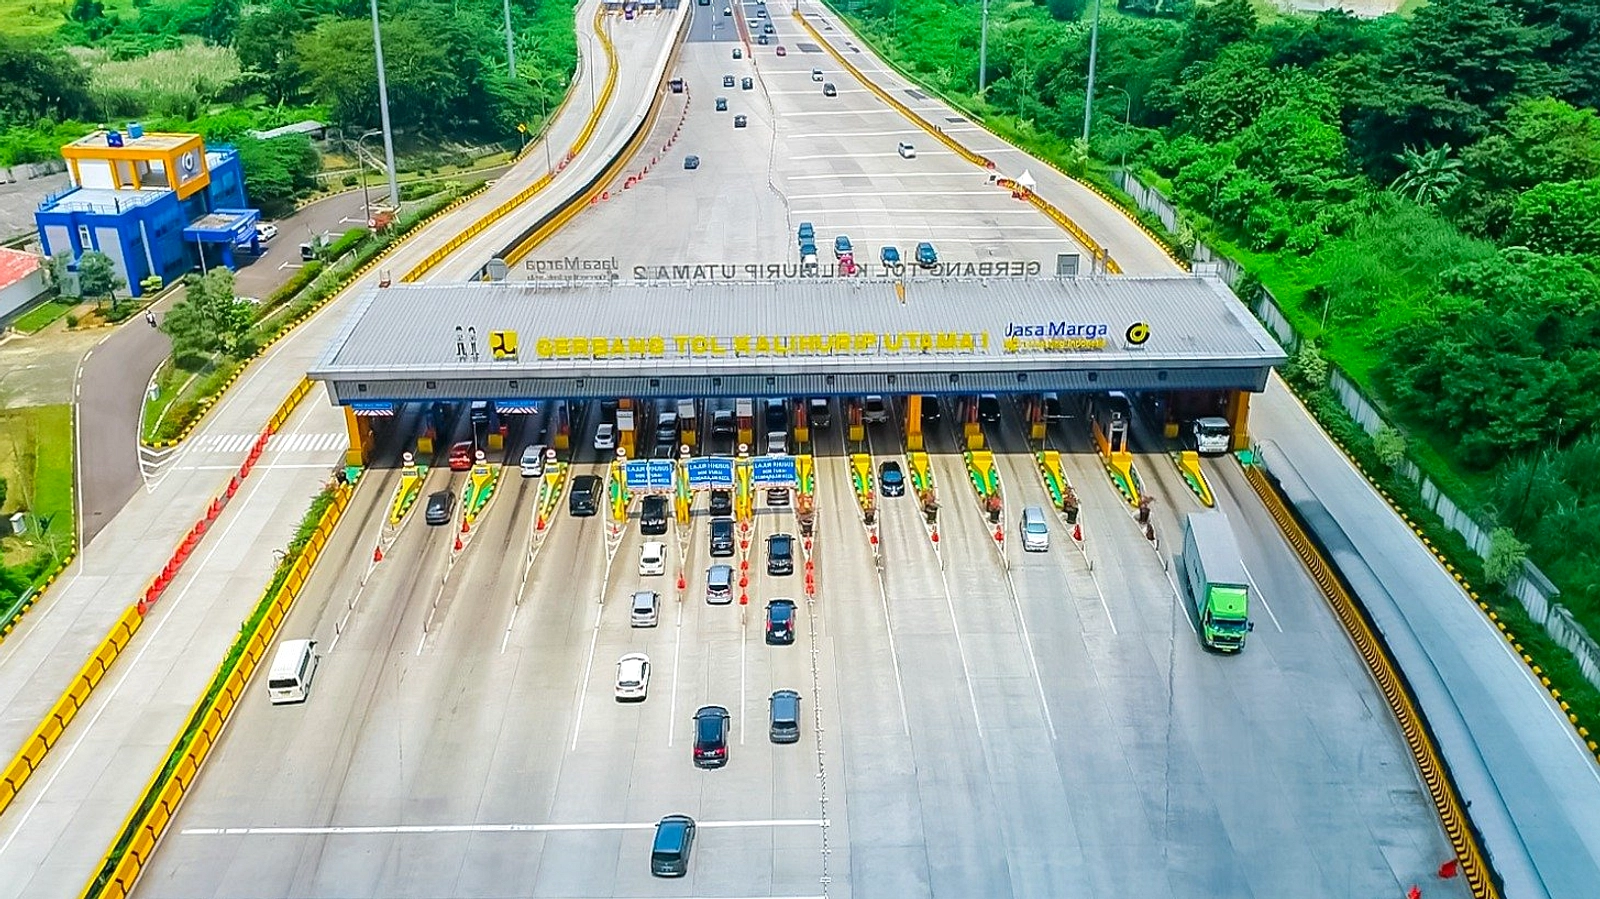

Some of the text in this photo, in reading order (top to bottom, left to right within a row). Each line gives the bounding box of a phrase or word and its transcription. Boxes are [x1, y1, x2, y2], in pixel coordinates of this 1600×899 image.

[1005, 321, 1108, 339] Jasa Marga
[536, 335, 664, 356] GERBANG
[673, 334, 726, 354] TOL
[733, 331, 876, 354] KALIHURIP
[884, 330, 974, 352] UTAMA
